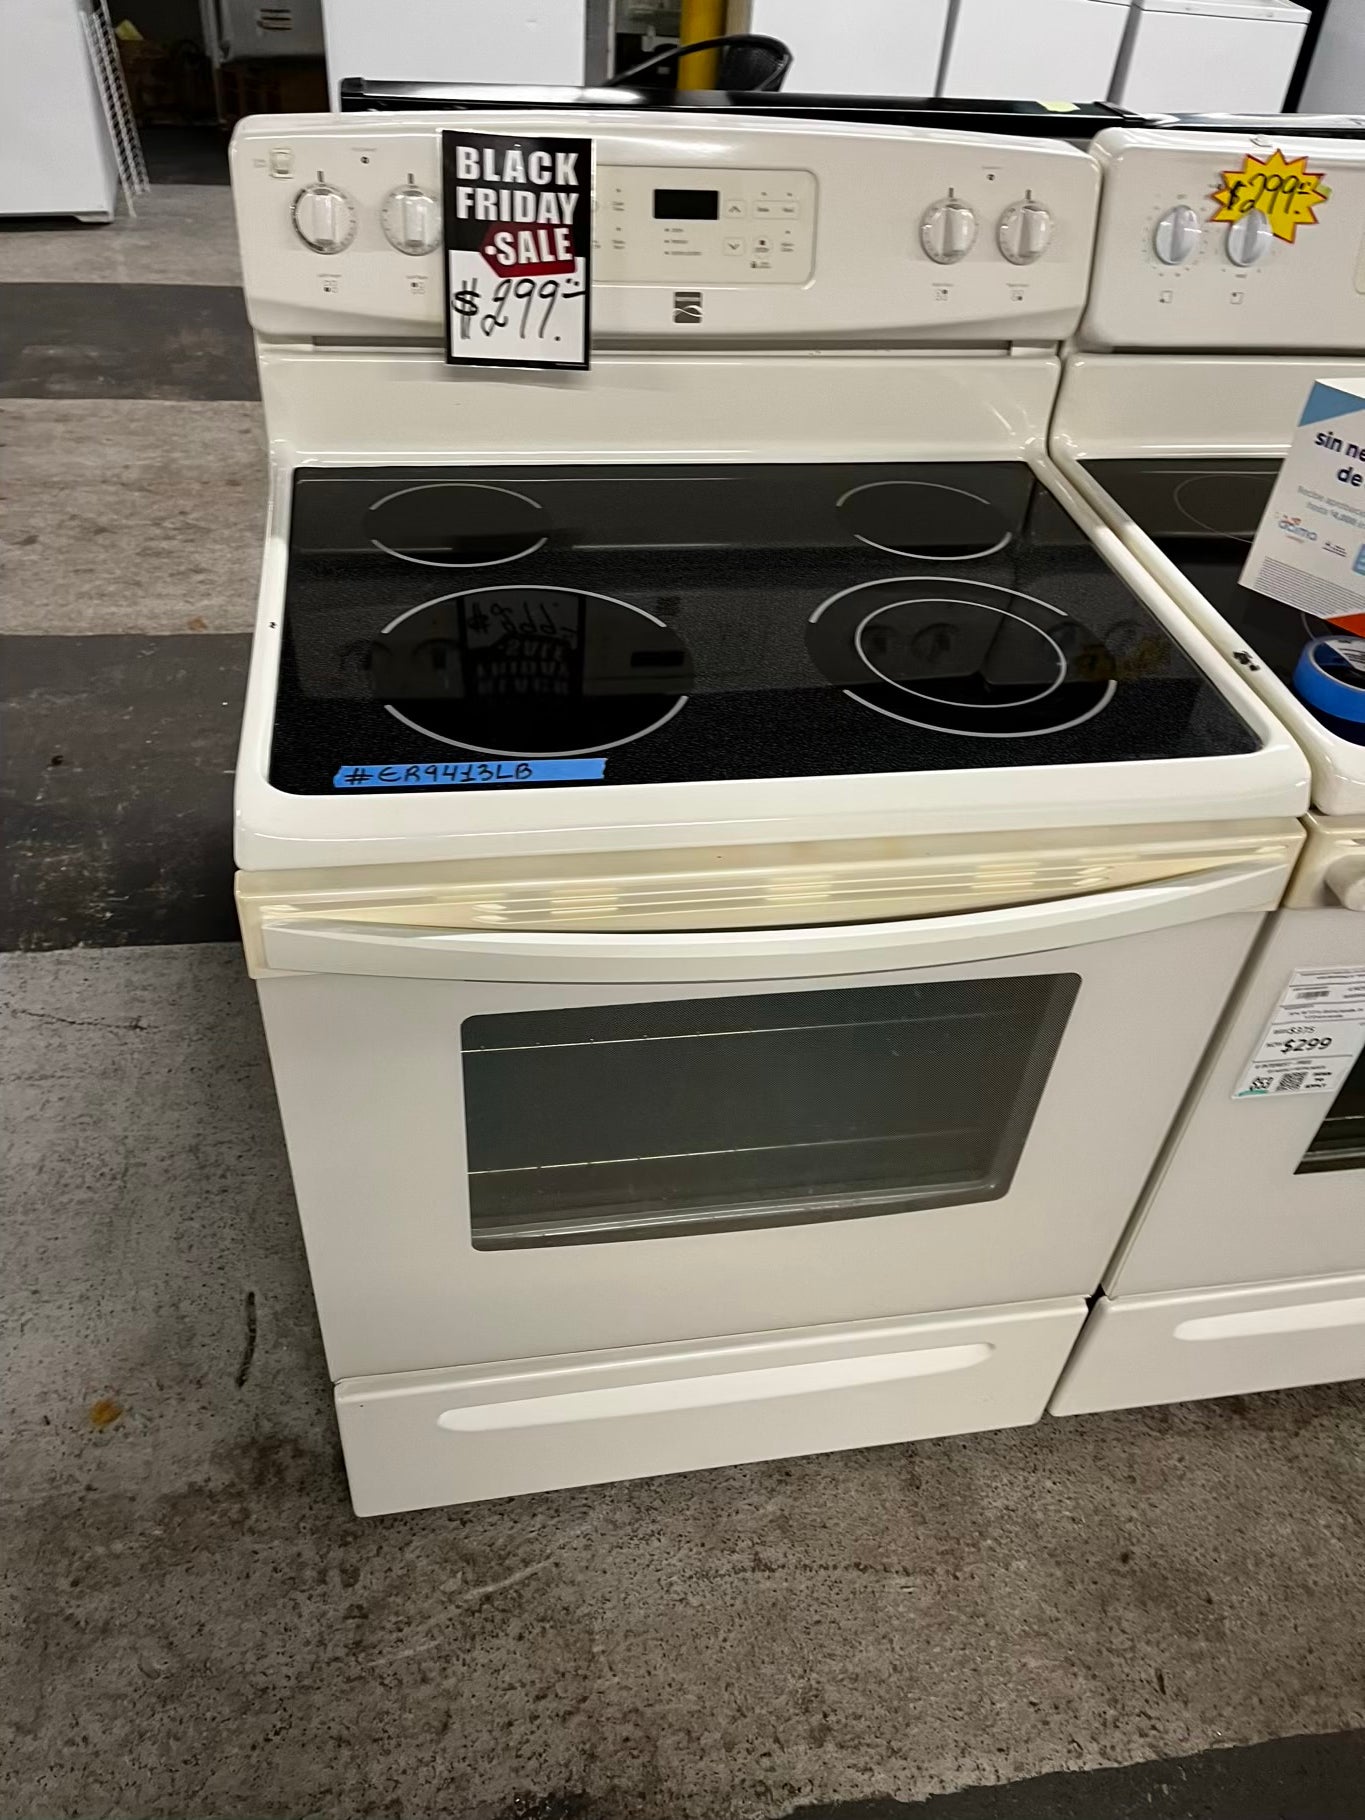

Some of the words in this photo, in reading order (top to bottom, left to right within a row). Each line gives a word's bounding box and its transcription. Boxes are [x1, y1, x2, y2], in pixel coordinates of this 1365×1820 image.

[455, 145, 579, 186] BLACK
[455, 186, 580, 225] FRIDAY
[493, 227, 574, 266] SALE
[1314, 431, 1343, 452] sin
[1337, 466, 1363, 487] de
[1280, 1036, 1333, 1055] $299
